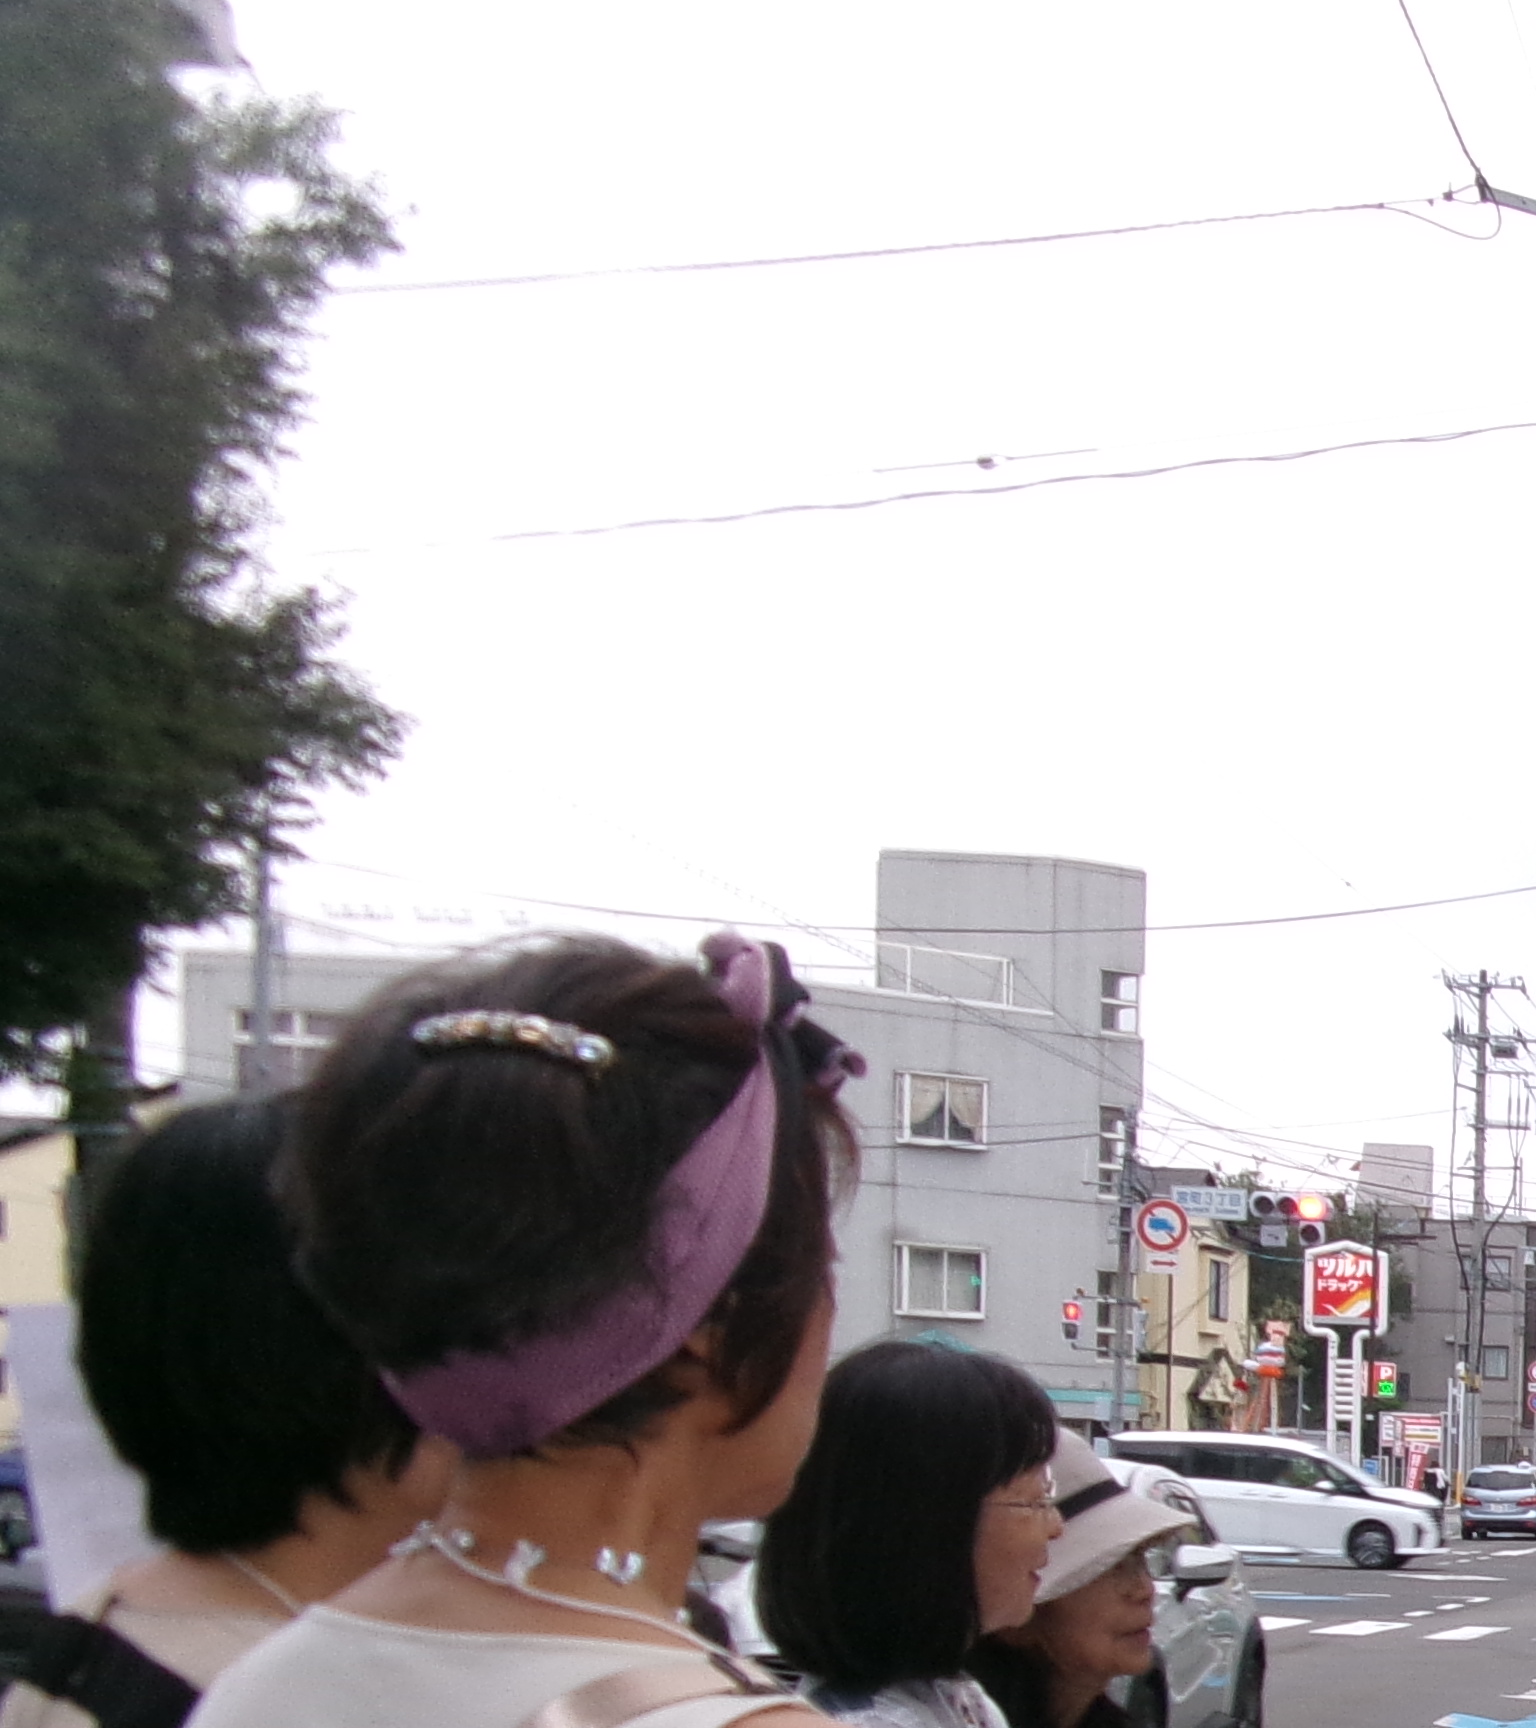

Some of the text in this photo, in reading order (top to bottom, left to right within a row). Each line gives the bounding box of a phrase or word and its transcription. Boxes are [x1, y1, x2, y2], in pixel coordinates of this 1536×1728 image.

[1317, 1258, 1373, 1277] ツルハ
[1317, 1278, 1364, 1292] ドラッグ
[1380, 1366, 1393, 1380] P
